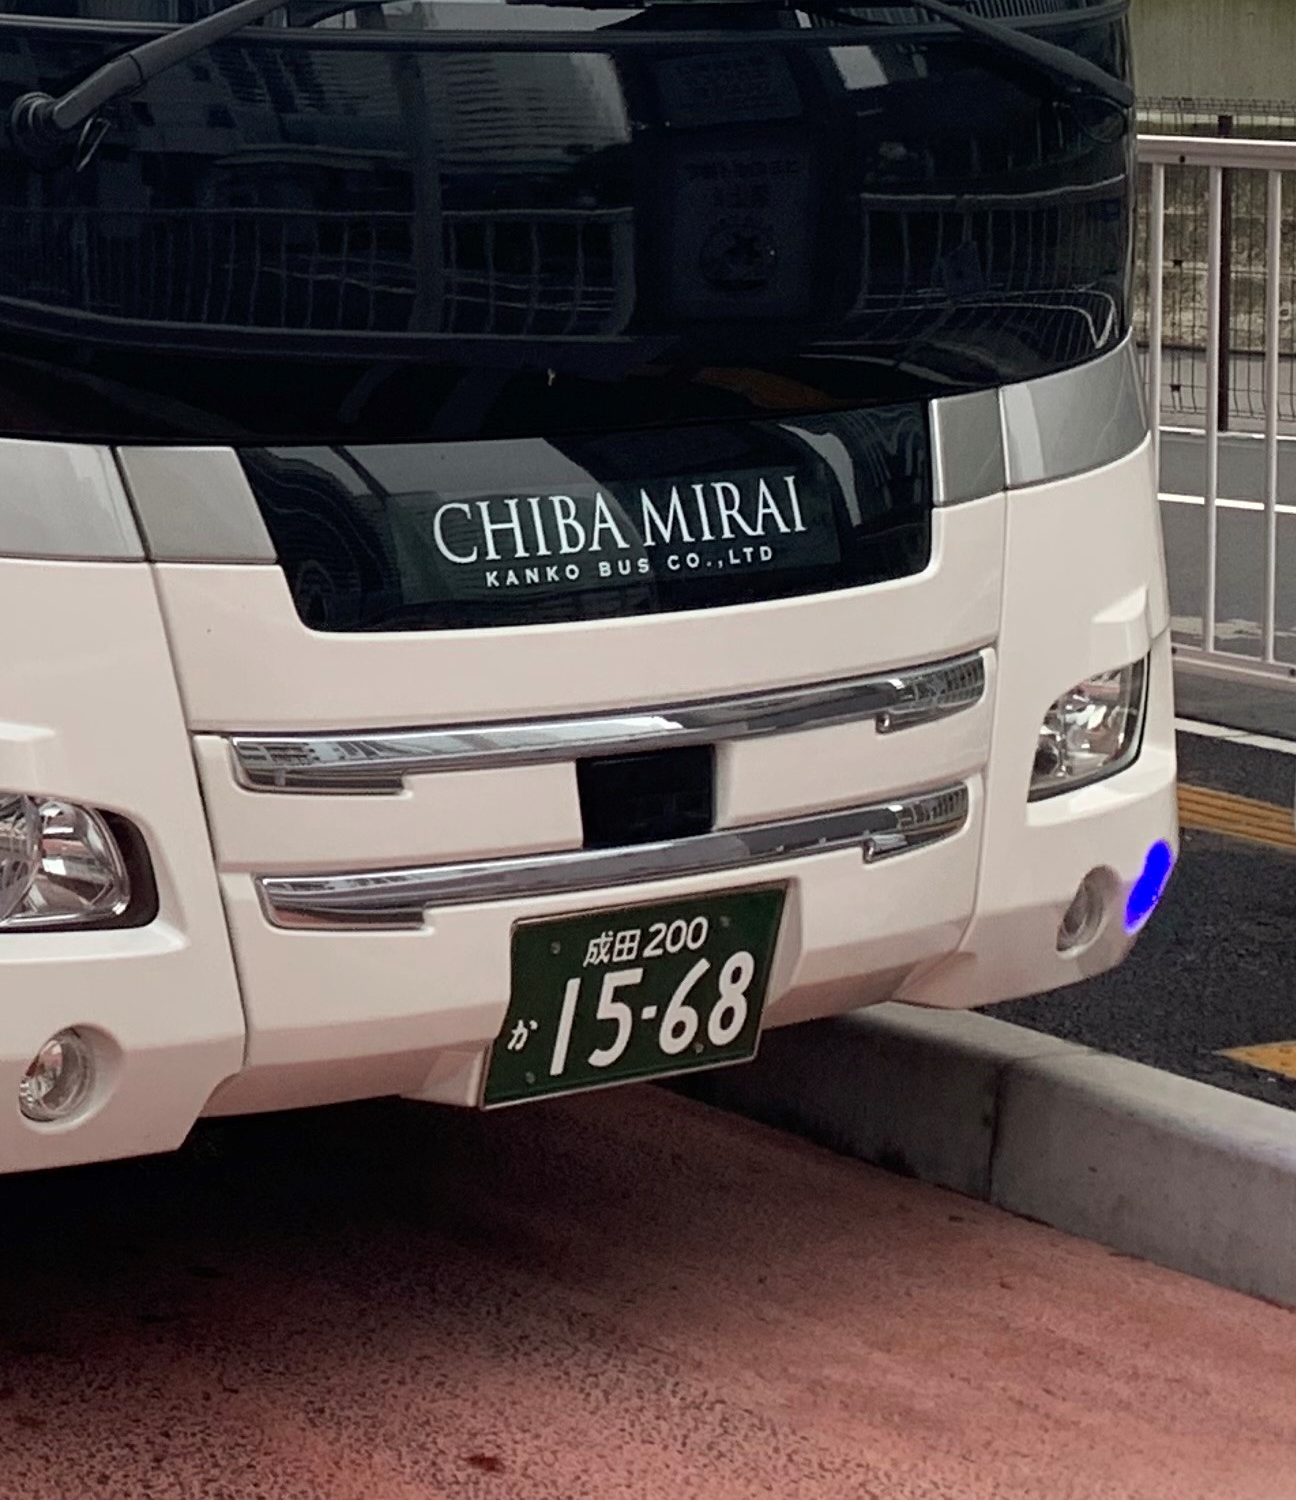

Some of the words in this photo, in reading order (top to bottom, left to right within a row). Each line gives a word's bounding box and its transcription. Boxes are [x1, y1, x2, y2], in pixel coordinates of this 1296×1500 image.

[433, 492, 629, 564] CHIBA
[640, 475, 807, 546] MIRAI
[486, 565, 581, 588] KANKO
[598, 557, 650, 578] BUS
[667, 545, 774, 571] CO.,LTD
[583, 929, 642, 967] 成田
[643, 916, 709, 958] 200
[507, 1018, 539, 1051] か
[550, 951, 755, 1076] 15-68
